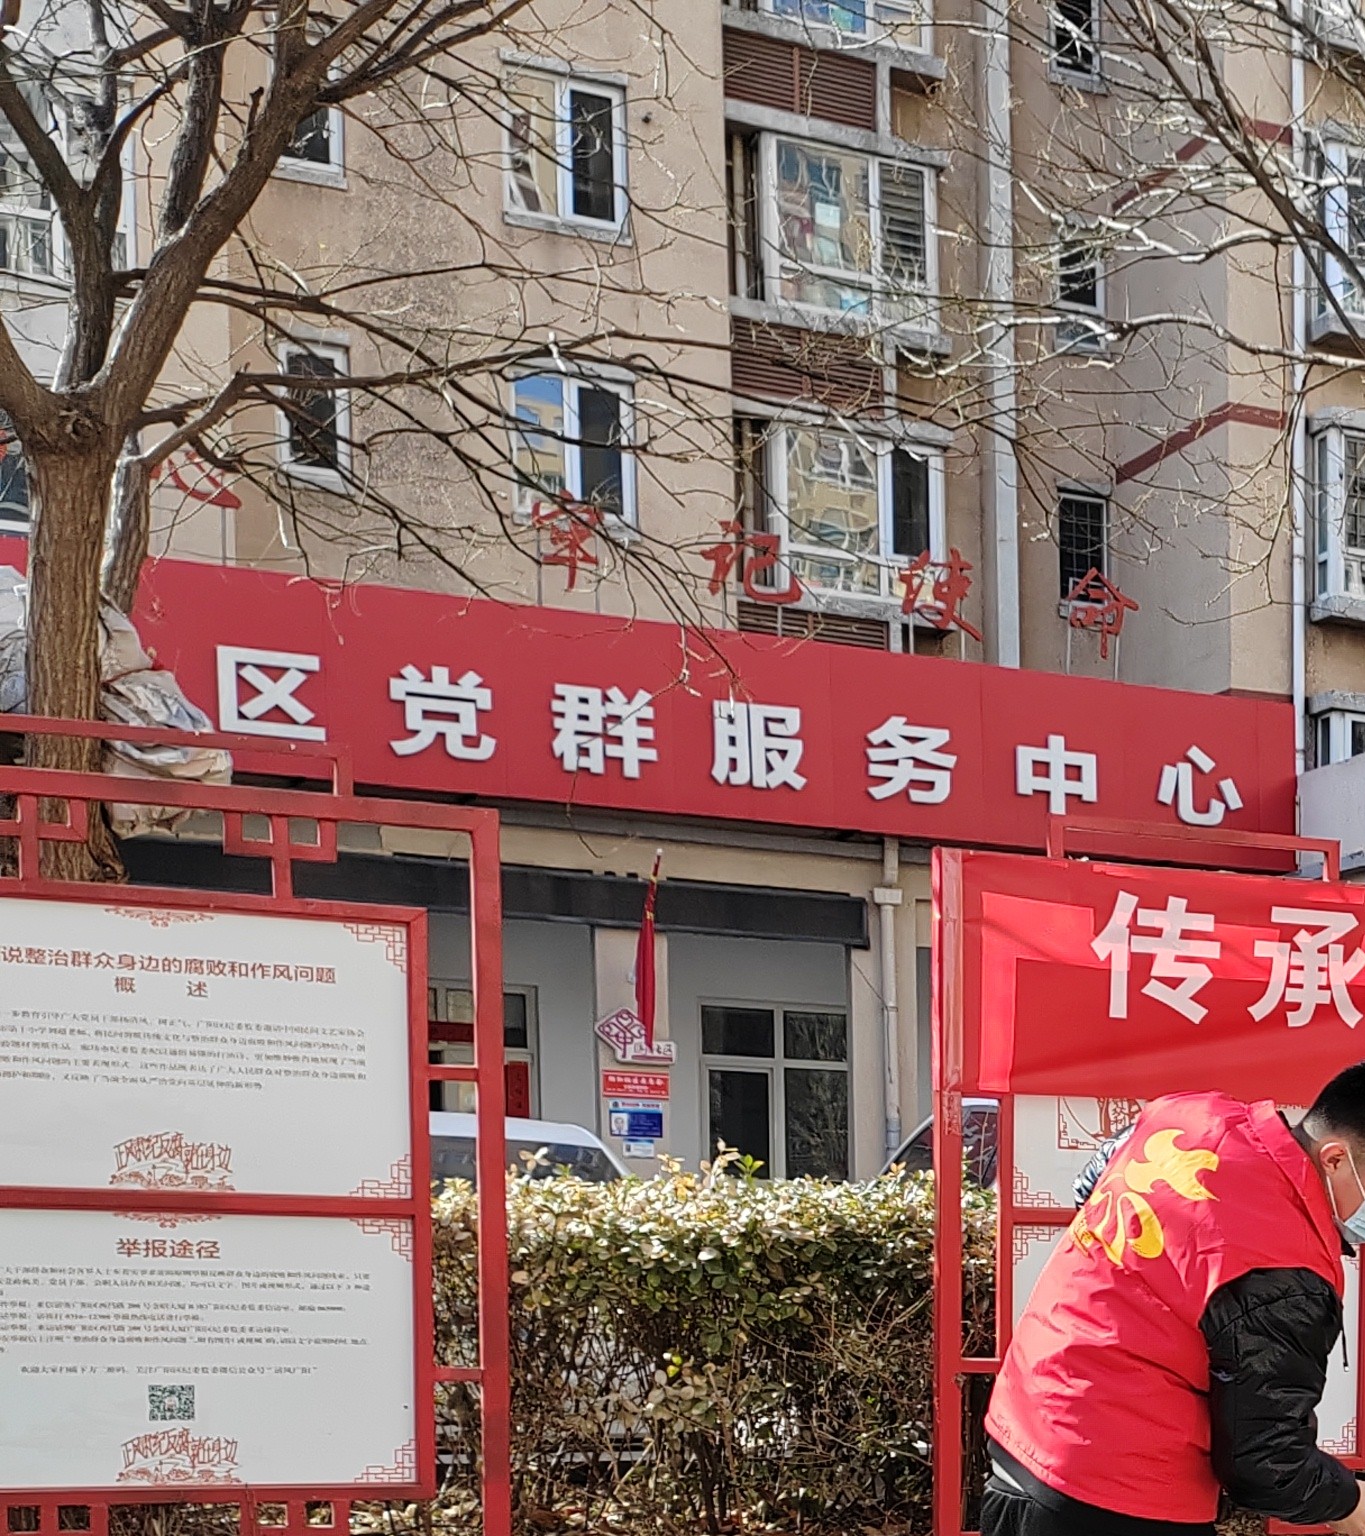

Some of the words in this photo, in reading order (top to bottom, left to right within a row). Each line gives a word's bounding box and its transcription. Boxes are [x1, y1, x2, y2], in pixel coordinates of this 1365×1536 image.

[215, 643, 1245, 827] 区党群服务中心
[1, 945, 337, 985] 说整治群众身边的腐败和作风问题
[115, 1237, 222, 1260] 举报途径
